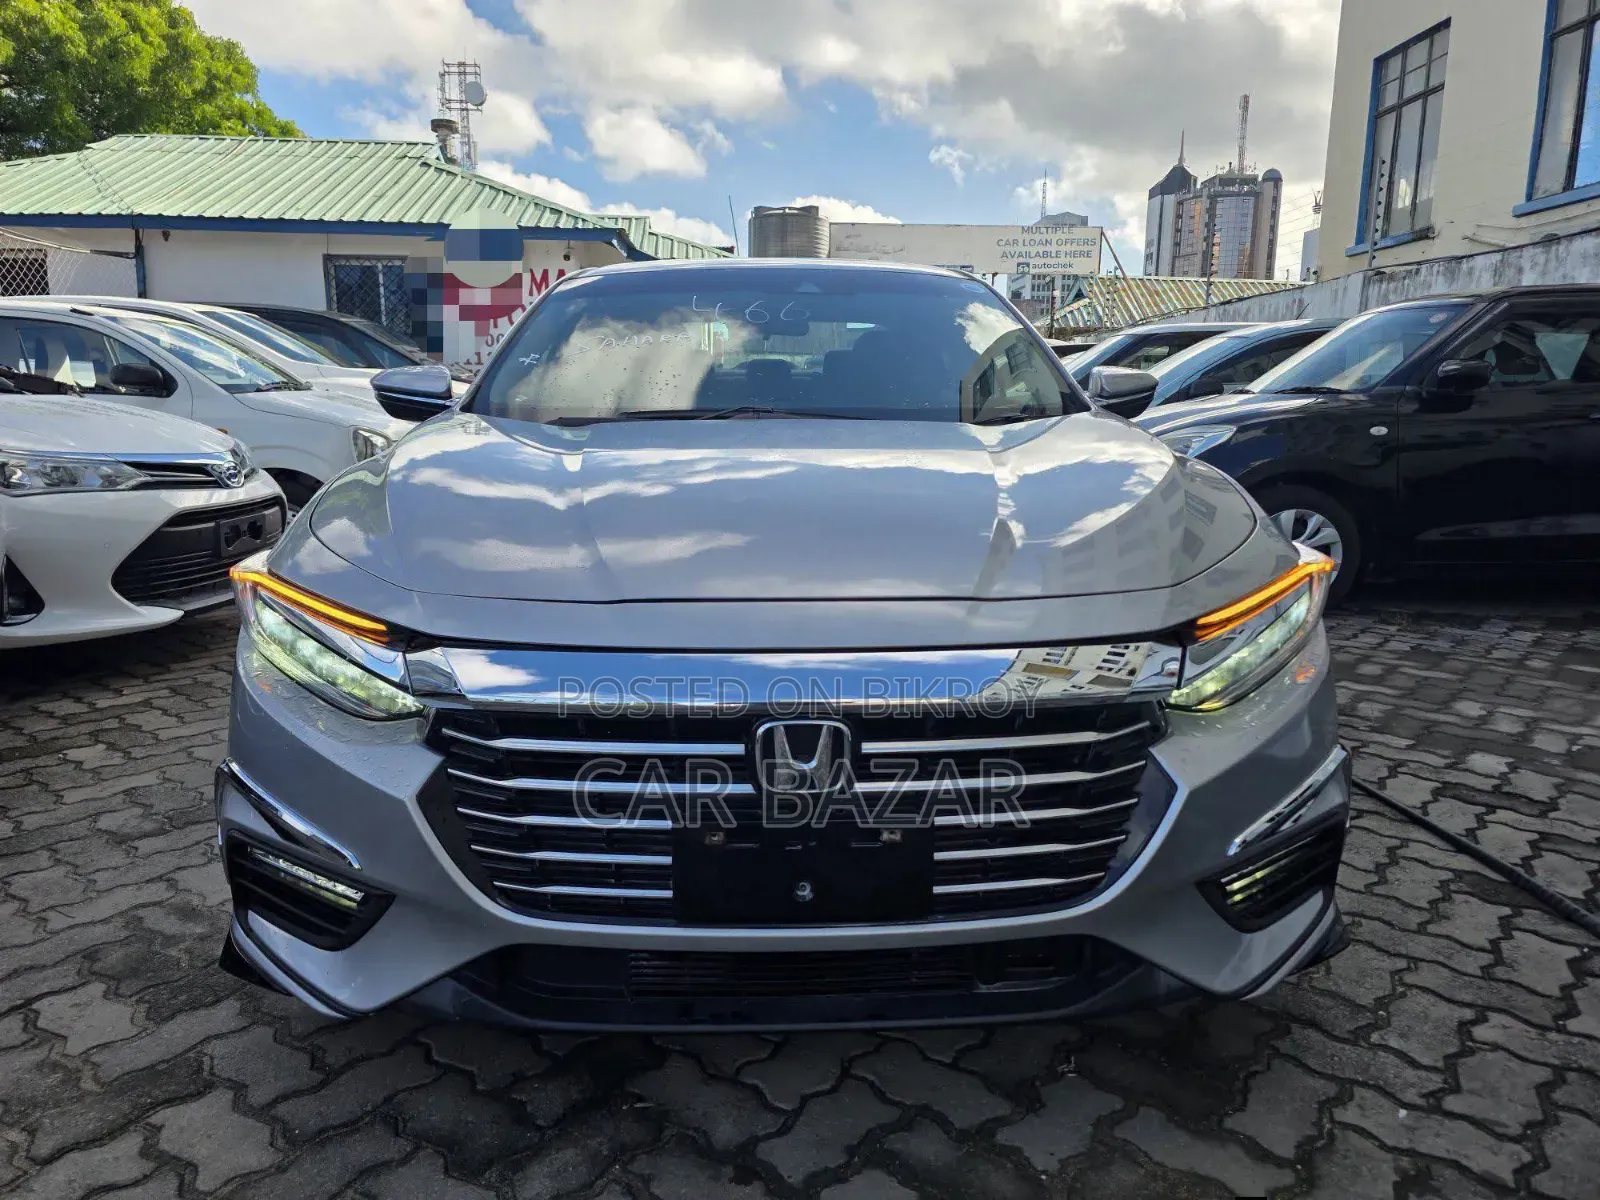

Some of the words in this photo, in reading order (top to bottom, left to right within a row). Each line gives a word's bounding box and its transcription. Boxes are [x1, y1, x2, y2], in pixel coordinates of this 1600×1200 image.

[1021, 226, 1074, 235] MULTIPLE
[996, 238, 1019, 247] CAR
[1022, 238, 1053, 247] LOAN
[1056, 237, 1097, 247] OFFERS
[1000, 250, 1062, 259] AVAILABLE
[1064, 250, 1093, 259] HERE
[1031, 261, 1074, 269] autochek
